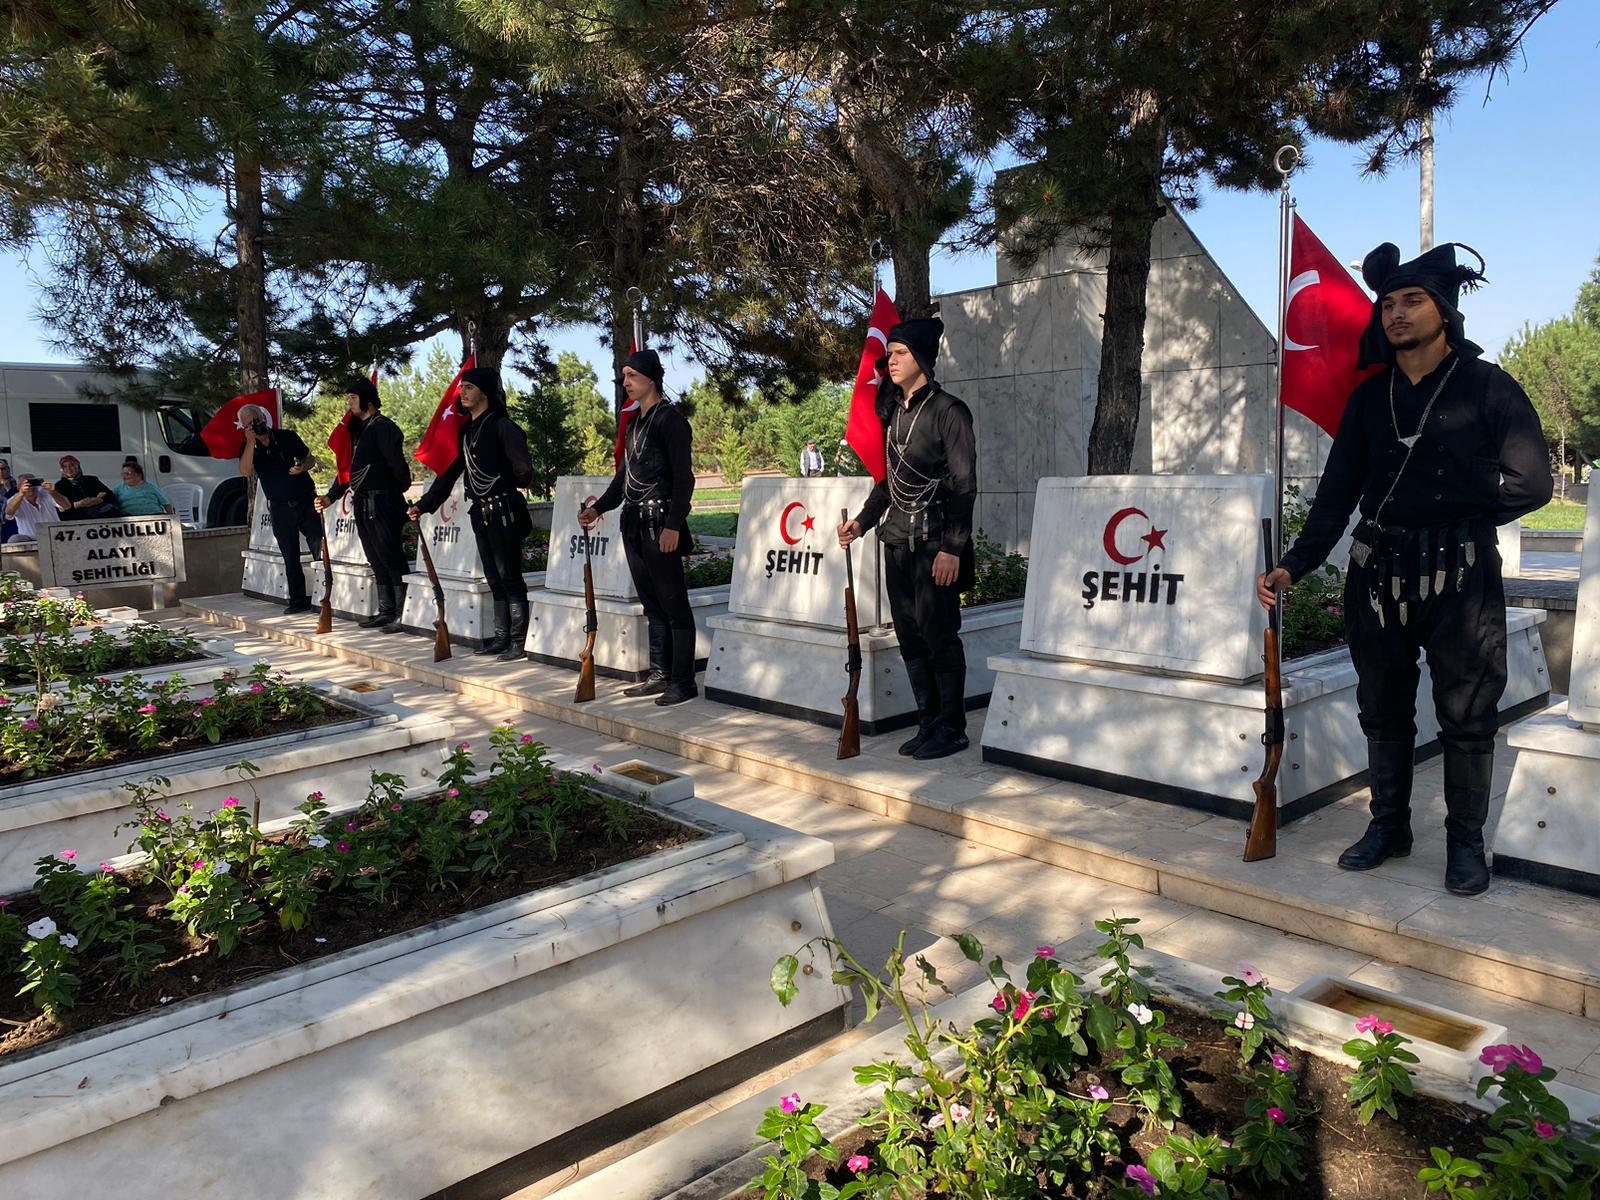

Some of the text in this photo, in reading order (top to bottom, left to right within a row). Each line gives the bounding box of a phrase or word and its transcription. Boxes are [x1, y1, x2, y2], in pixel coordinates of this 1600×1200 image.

[55, 530, 81, 542] 47.
[433, 522, 461, 546] ŞEHİT
[87, 546, 136, 560] ALAYI
[765, 545, 824, 578] ŞEHİT
[72, 561, 155, 583] ŞEHİTLİĞİ
[1082, 563, 1184, 609] ŞEHİT
